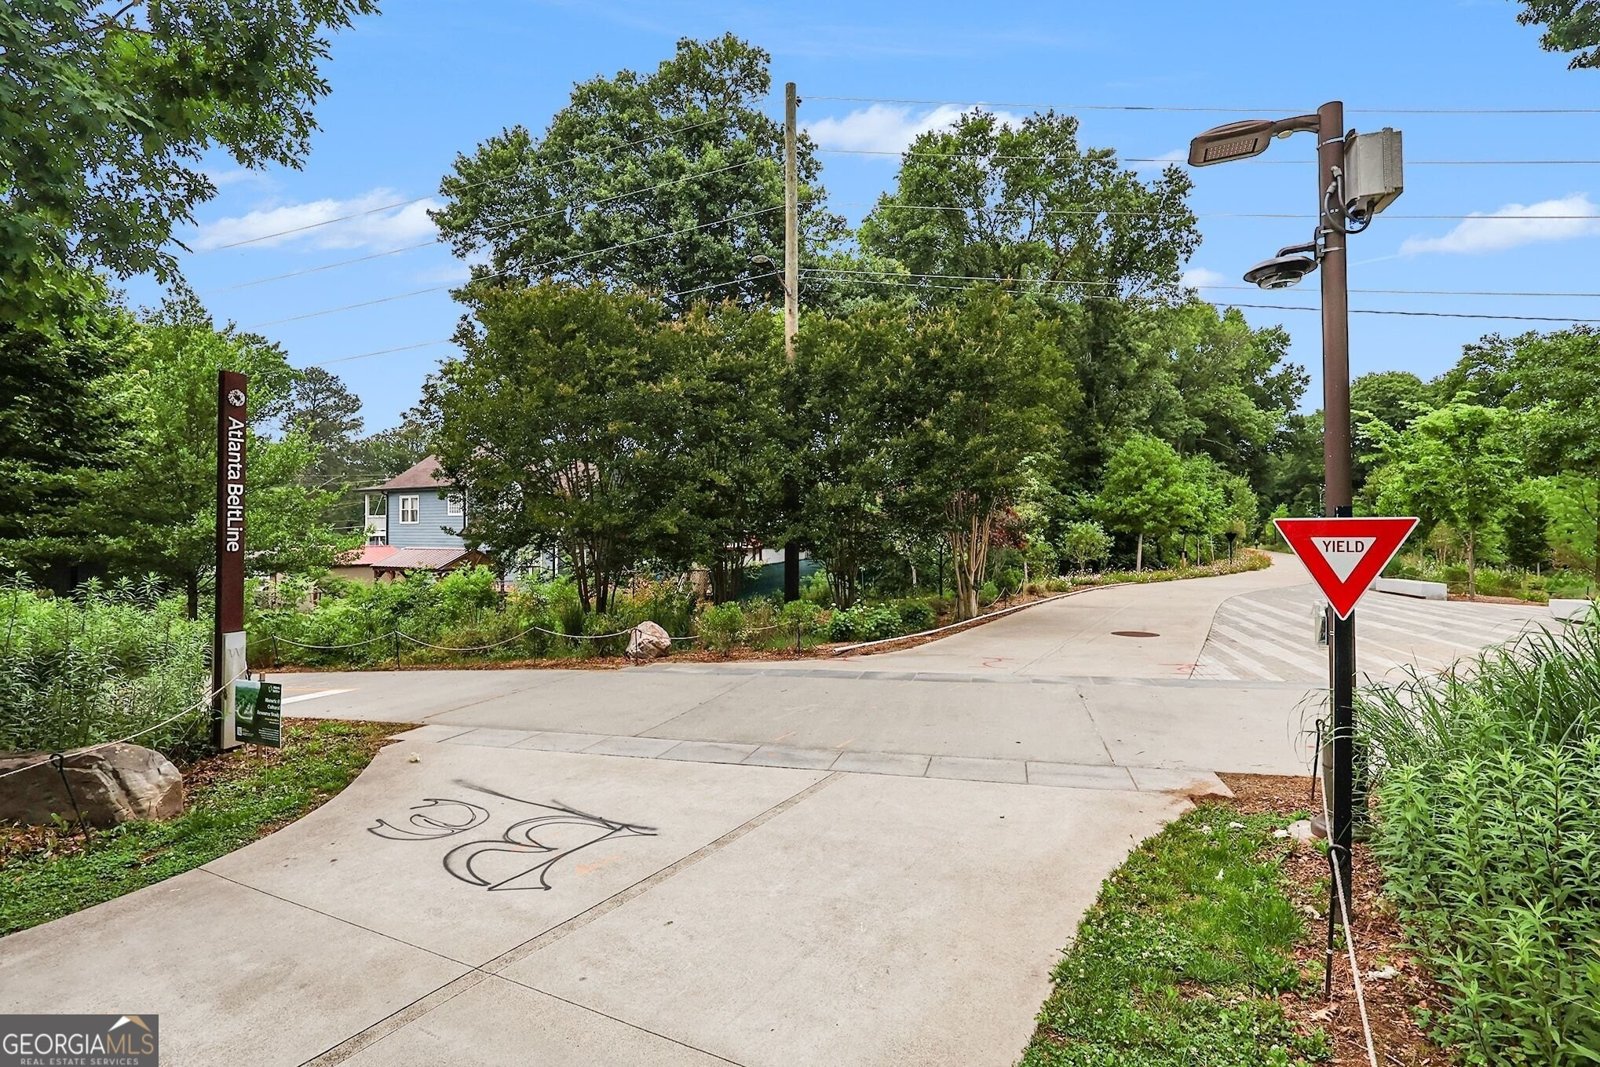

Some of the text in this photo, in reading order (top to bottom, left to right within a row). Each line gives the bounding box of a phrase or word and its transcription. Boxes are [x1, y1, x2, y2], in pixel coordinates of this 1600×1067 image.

[226, 416, 245, 552] Atlanta BeltLine
[1322, 540, 1365, 553] YIELD
